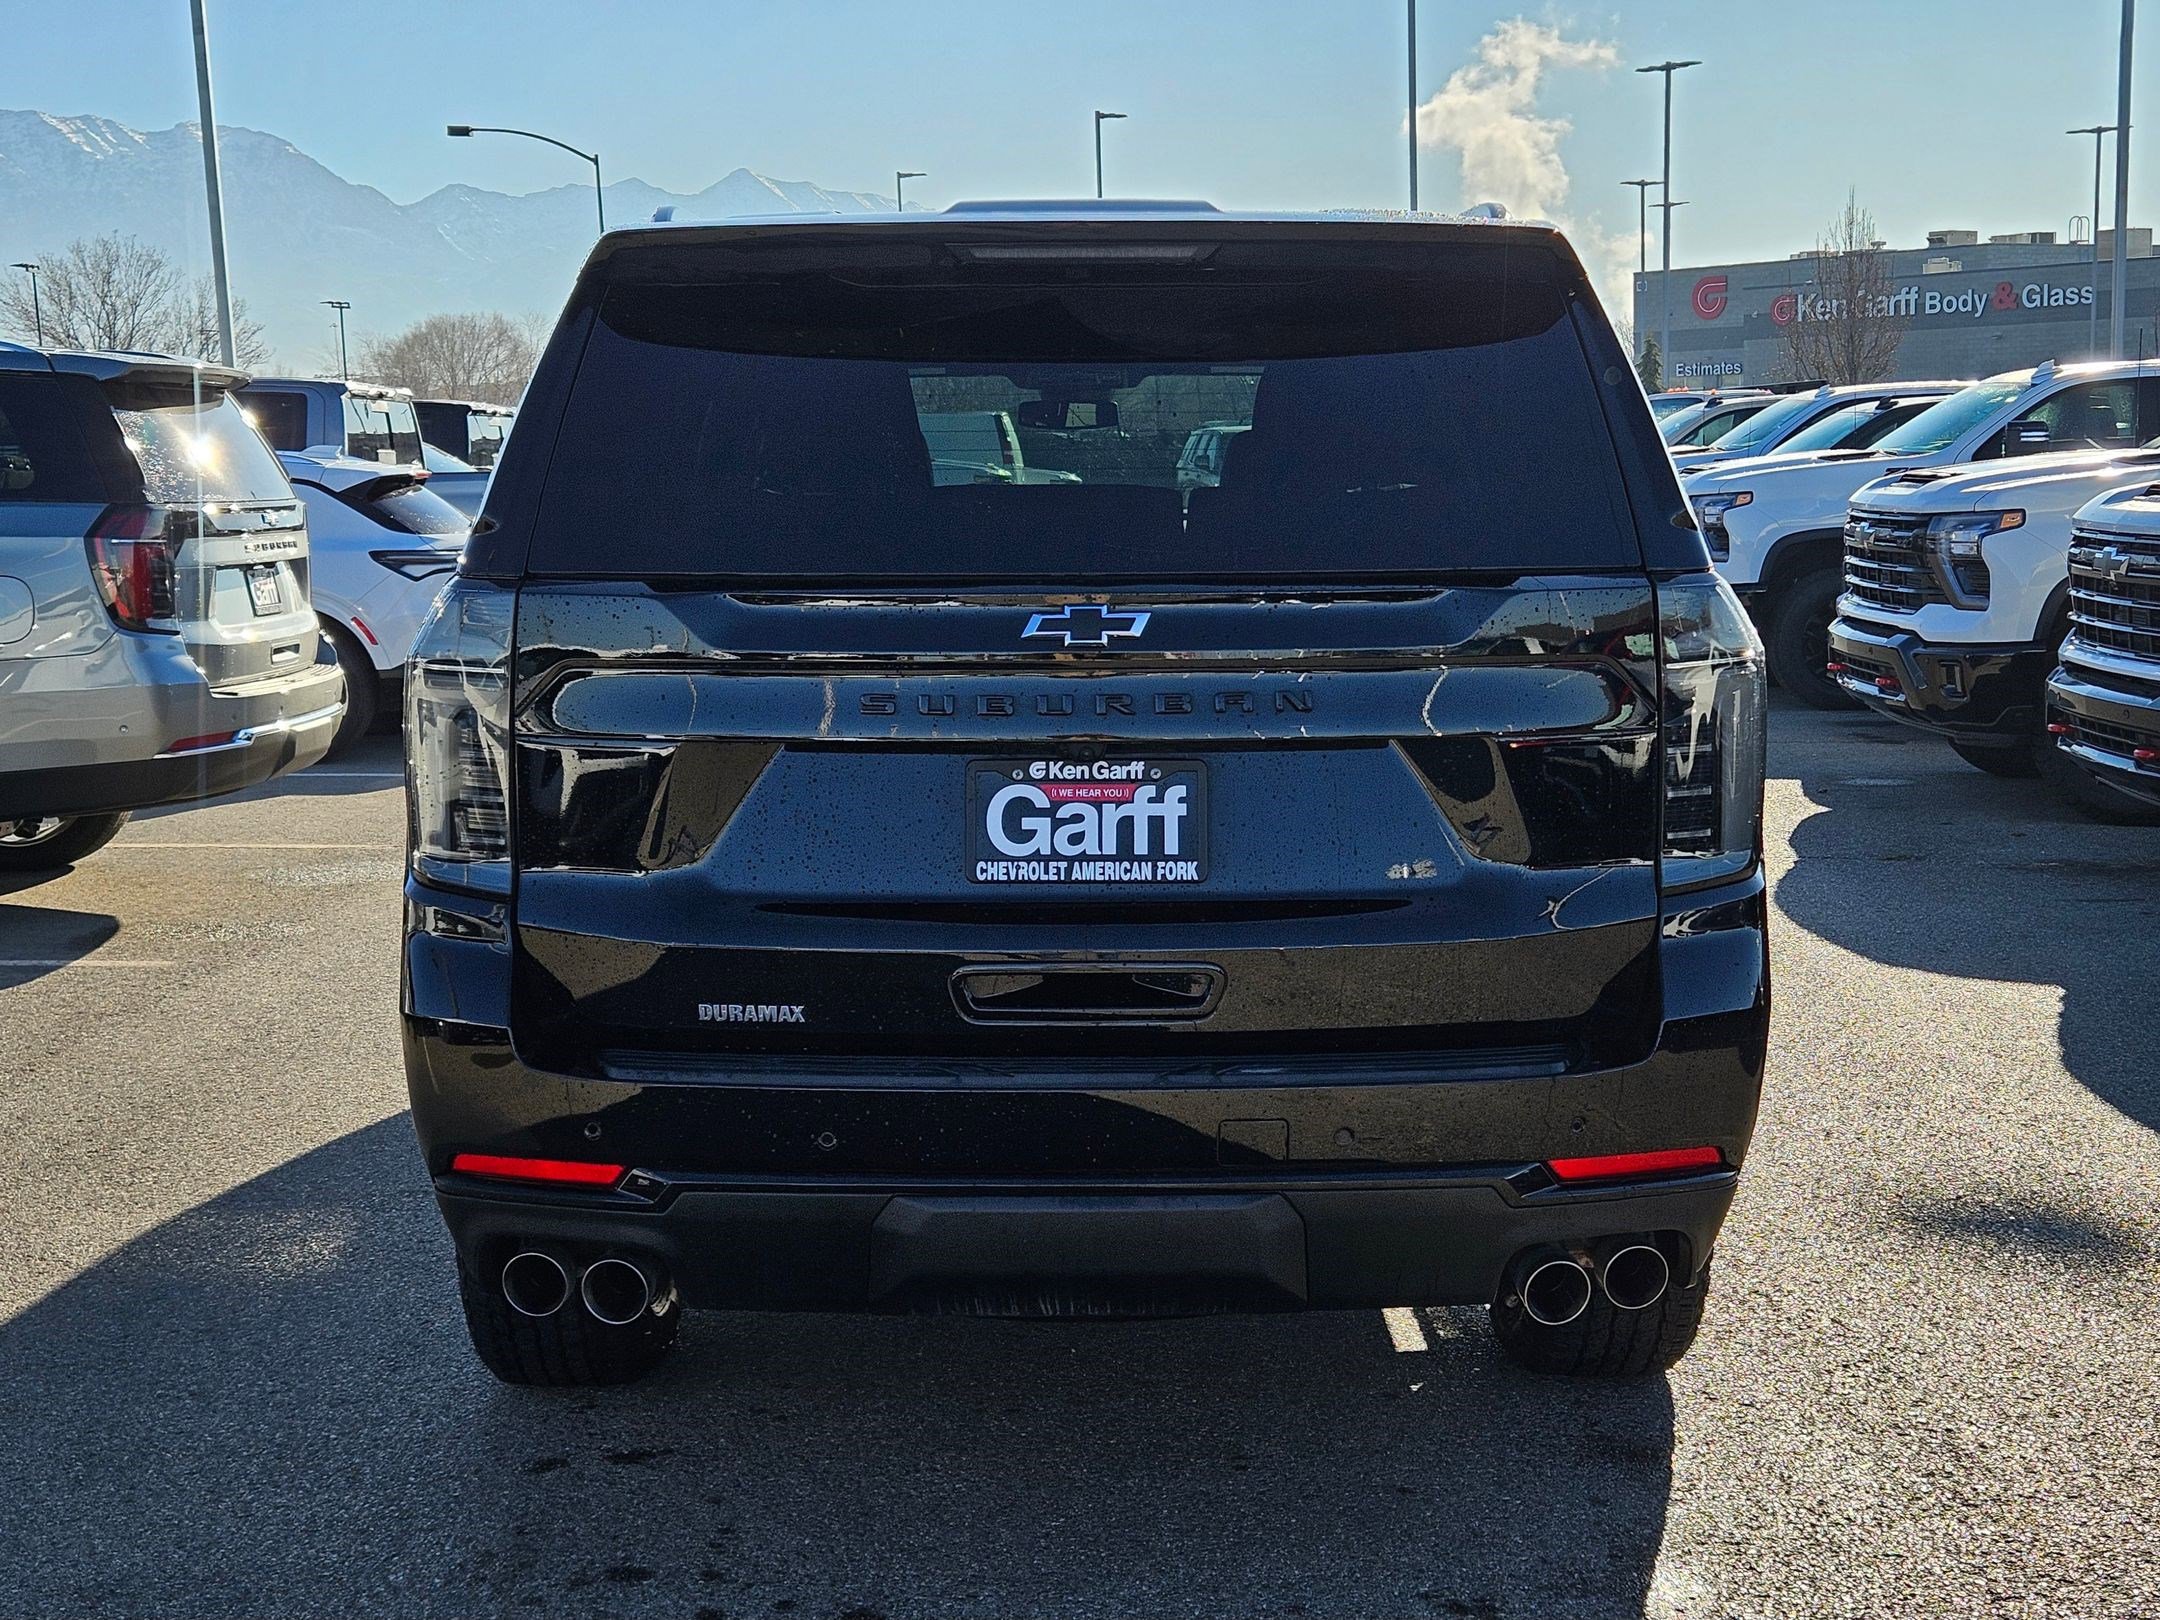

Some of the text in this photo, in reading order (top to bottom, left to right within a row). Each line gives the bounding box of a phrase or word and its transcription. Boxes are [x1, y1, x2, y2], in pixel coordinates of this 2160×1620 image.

[1924, 289, 1989, 318] Body
[1992, 281, 2019, 310] &
[2022, 283, 2094, 309] Glass
[1676, 361, 1742, 377] Estimates
[859, 689, 1314, 716] SUBURBAN
[1049, 762, 1089, 779] Ken
[1092, 761, 1145, 780] Garff
[1059, 788, 1122, 797] WE HEAR YOU
[986, 784, 1187, 857] Garff
[976, 861, 1199, 881] CHEVROLET AMERICAN FORK
[698, 1003, 805, 1023] DURAMAX
